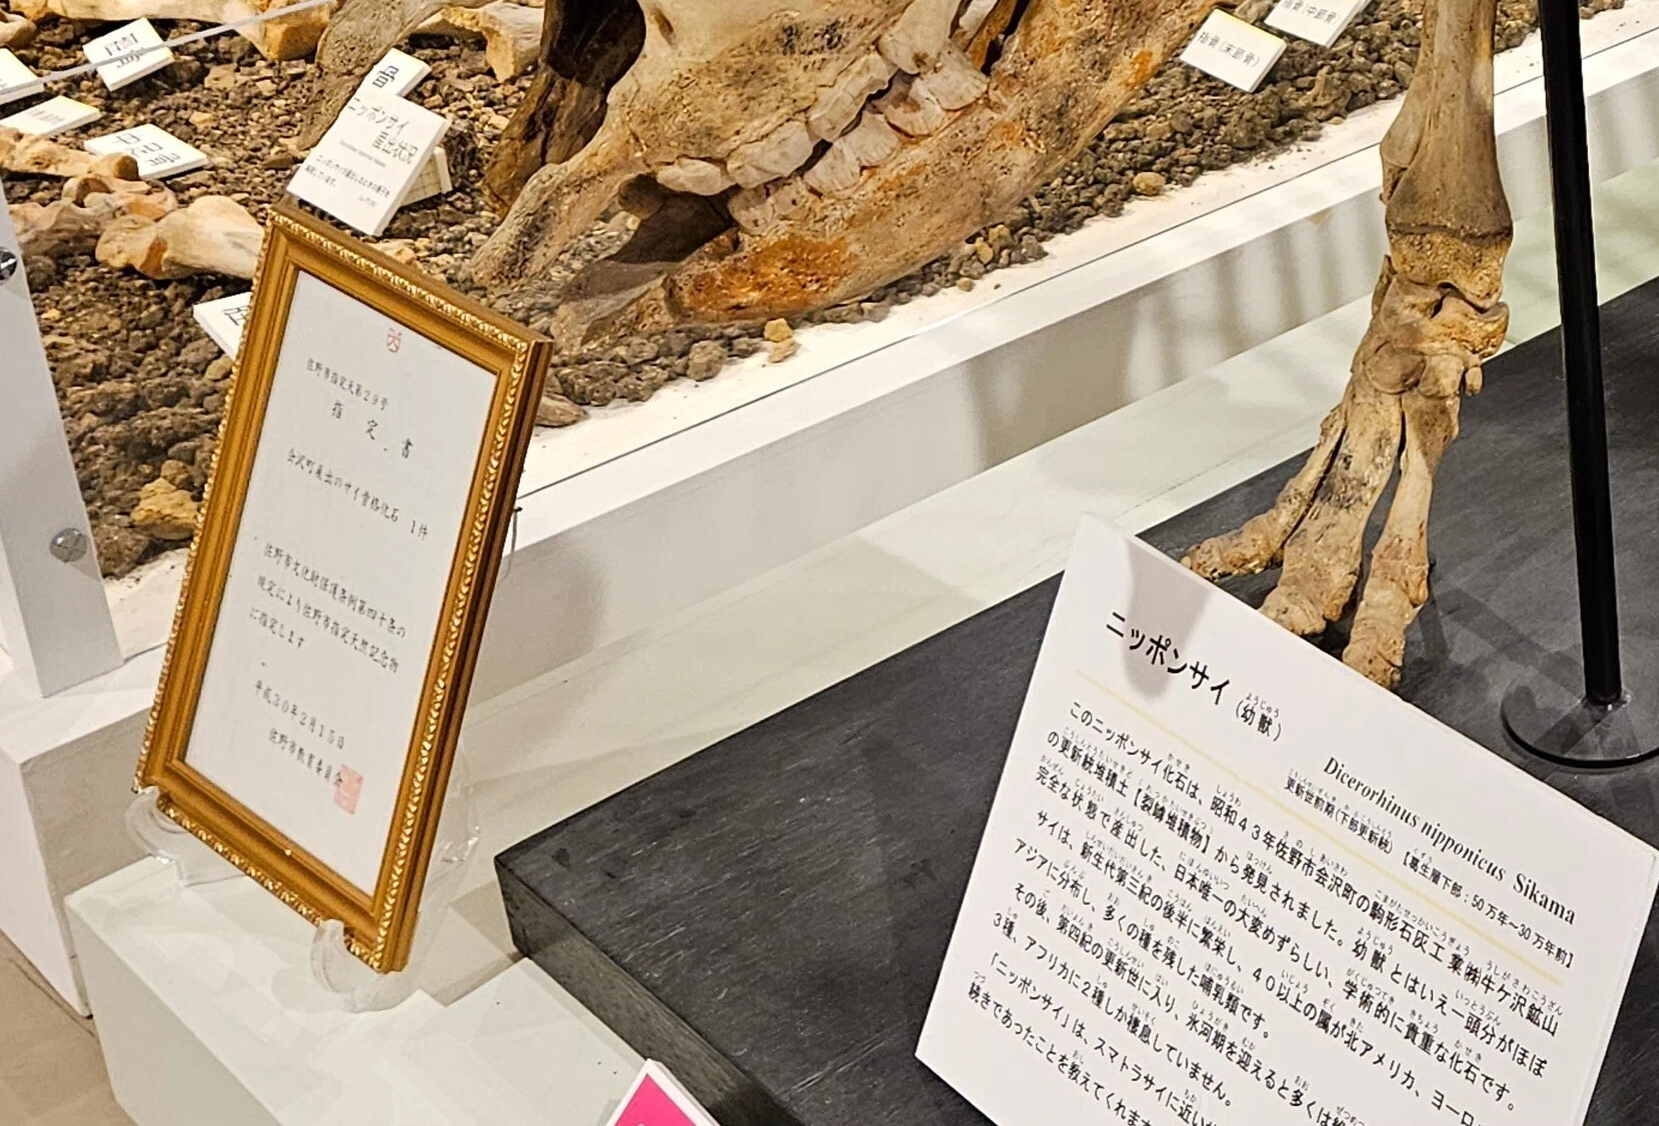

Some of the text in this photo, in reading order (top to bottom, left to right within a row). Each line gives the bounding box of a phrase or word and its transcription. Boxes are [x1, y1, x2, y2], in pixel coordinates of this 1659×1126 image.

[1106, 612, 1230, 705] ニッポンサイ
[1323, 757, 1575, 926] Dicerorhinus nipponicus Sikama
[991, 952, 1215, 1126] 「ニッポンサイ」は、スマトラサイに近い
[1037, 810, 1484, 1126] サイは、新生代第三紀の後半に繁栄し、40以上の属が北アメリカ、ヨーロ
